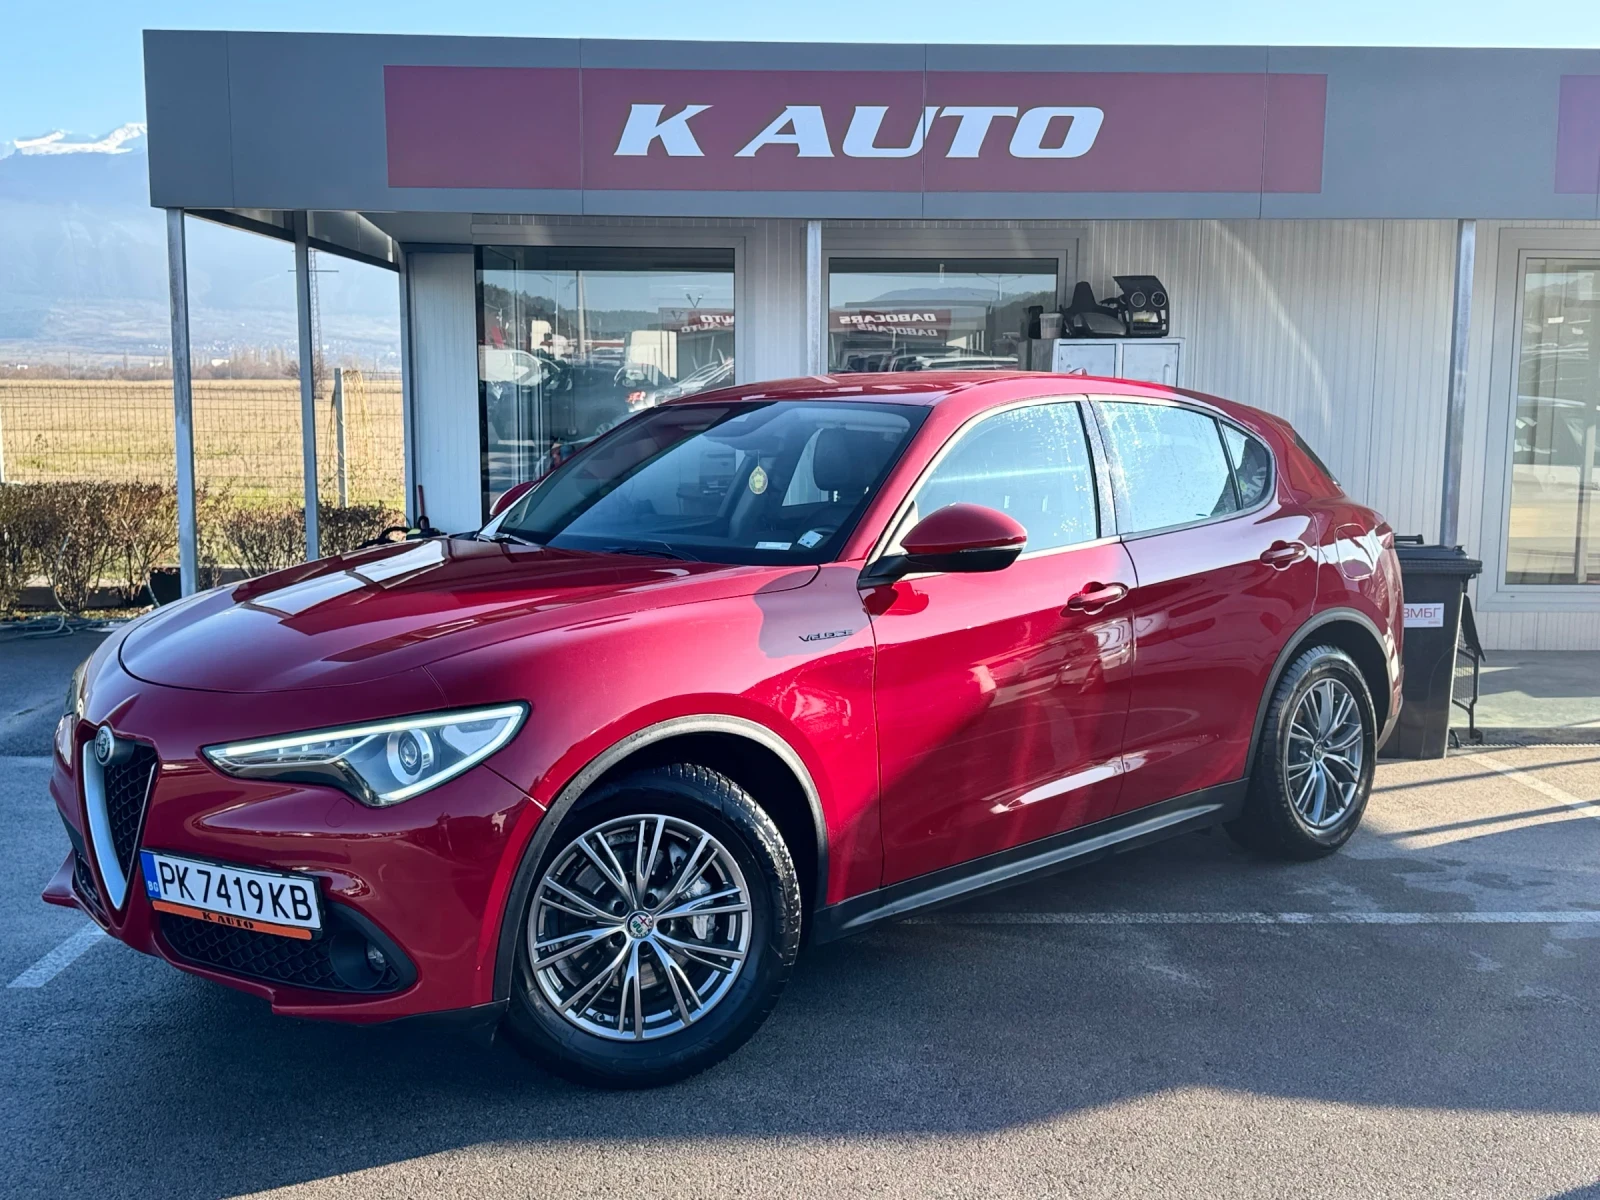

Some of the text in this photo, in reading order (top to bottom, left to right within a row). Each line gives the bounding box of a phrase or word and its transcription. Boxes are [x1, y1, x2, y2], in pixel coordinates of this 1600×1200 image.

[613, 104, 1105, 158] K AUTO
[798, 629, 854, 642] VELOCE
[147, 880, 159, 892] BG
[202, 911, 254, 930] K AUTO
